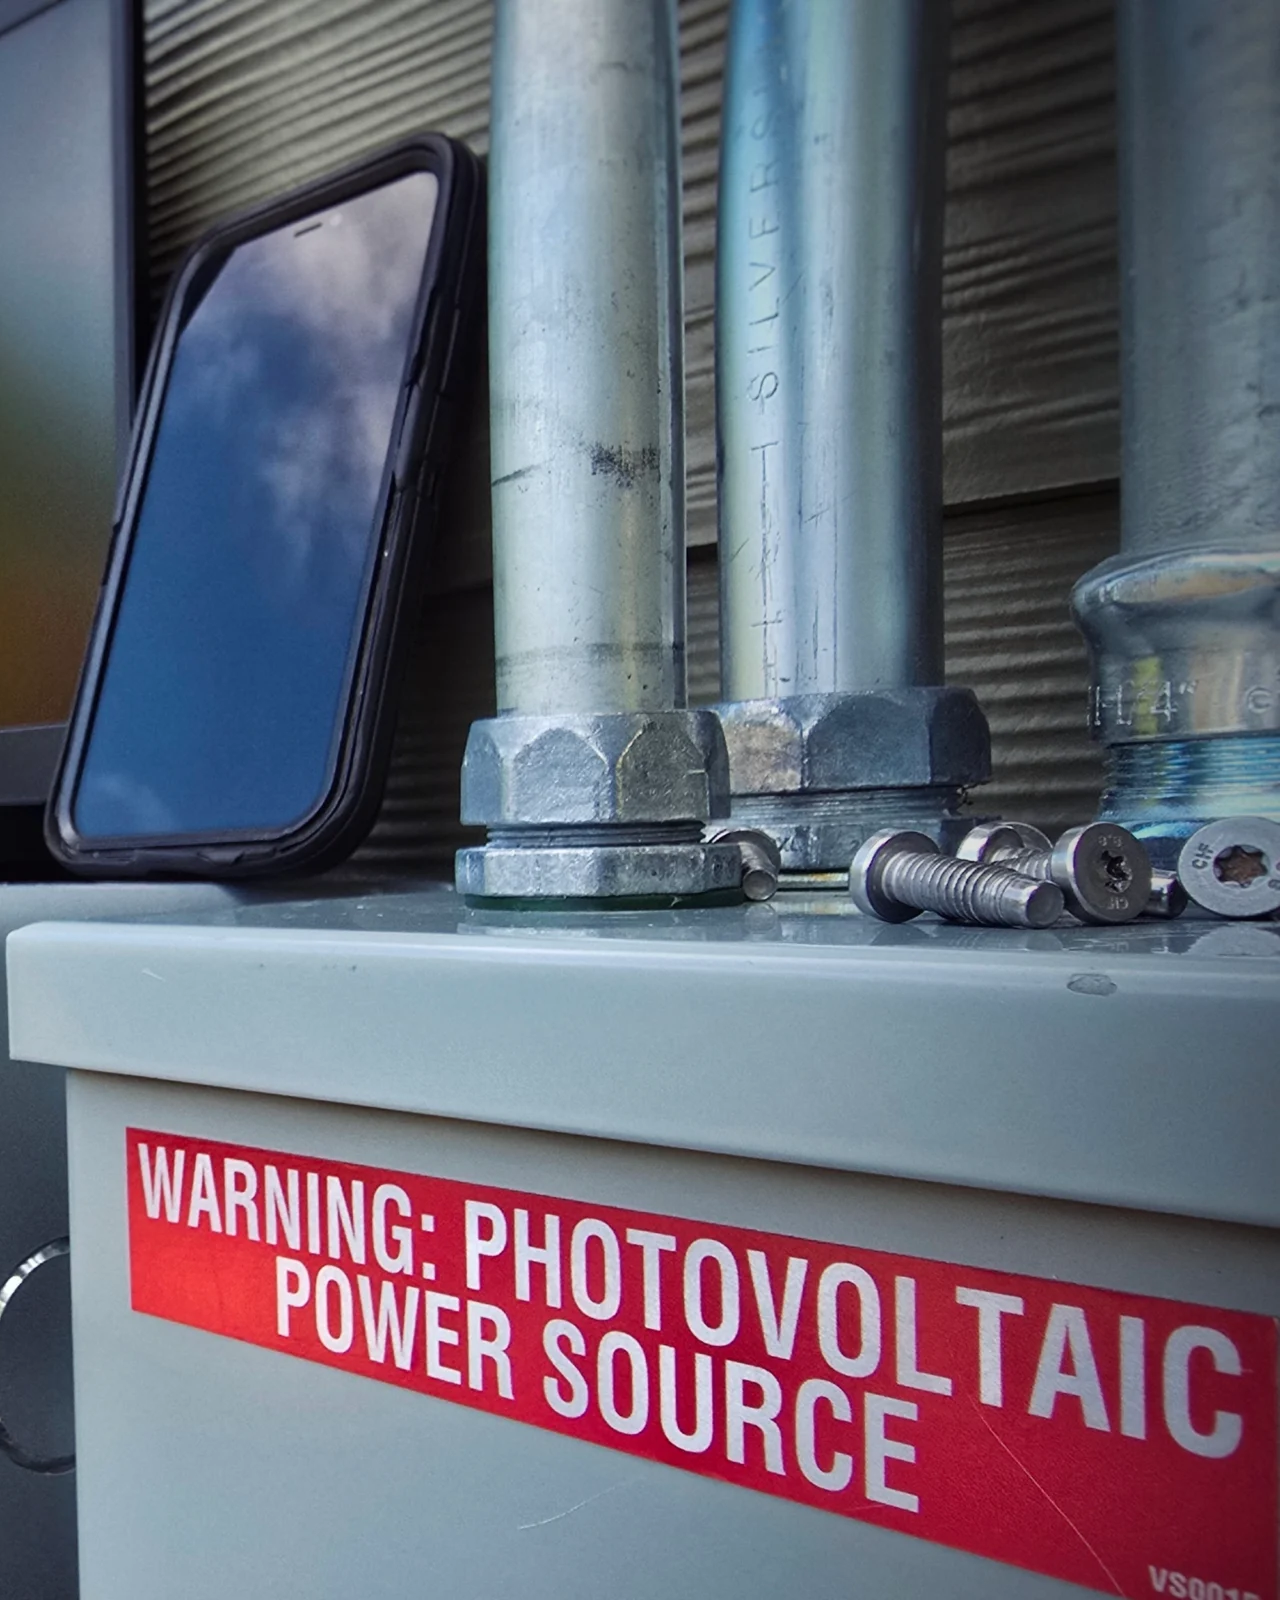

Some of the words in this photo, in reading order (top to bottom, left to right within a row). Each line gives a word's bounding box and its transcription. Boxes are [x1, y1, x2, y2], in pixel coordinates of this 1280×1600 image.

[136, 1142, 437, 1281] WARNING:
[464, 1198, 1244, 1460] PHOTOVOLTAIC
[275, 1255, 515, 1401] POWER
[542, 1318, 920, 1514] SOURCE
